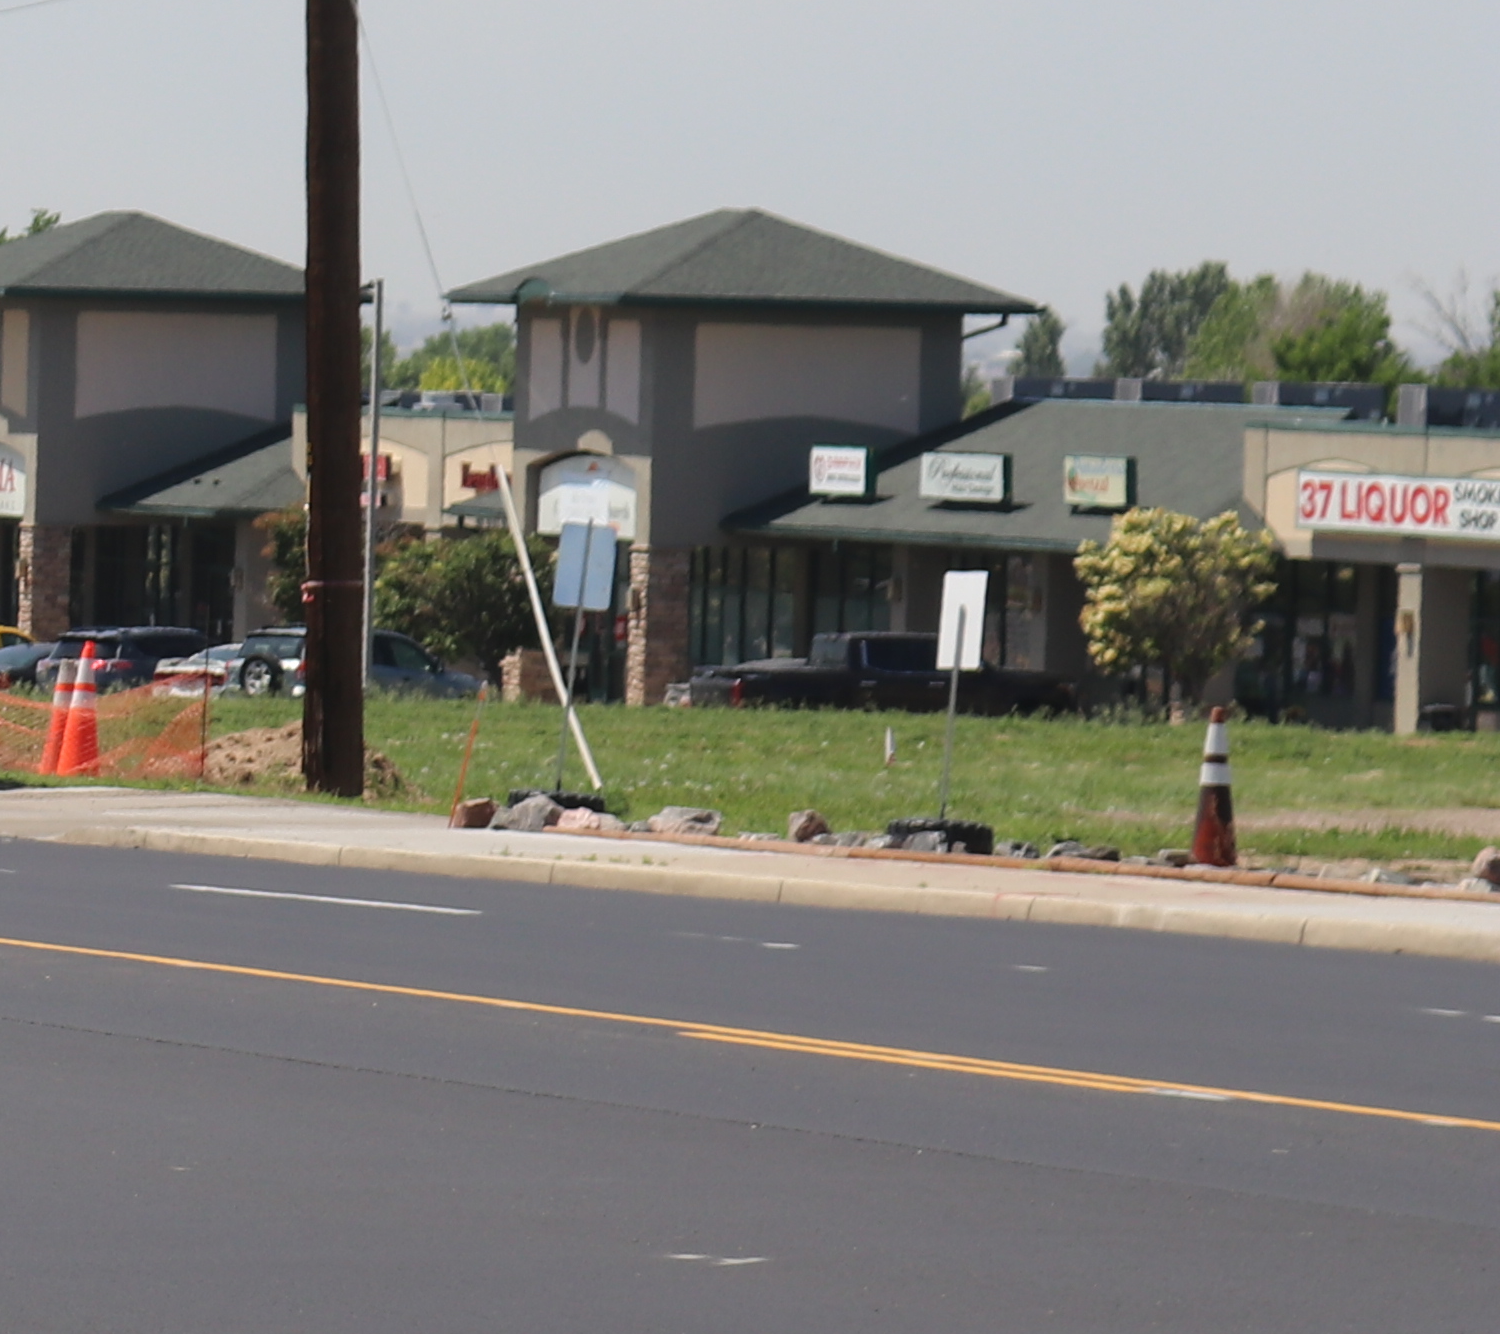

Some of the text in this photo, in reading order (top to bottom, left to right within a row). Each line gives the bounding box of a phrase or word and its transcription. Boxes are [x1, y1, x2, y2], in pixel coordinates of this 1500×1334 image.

[1301, 479, 1451, 525] 37 LIQUOR
[1454, 481, 1500, 505] SMOK
[1460, 509, 1498, 530] SHOP
